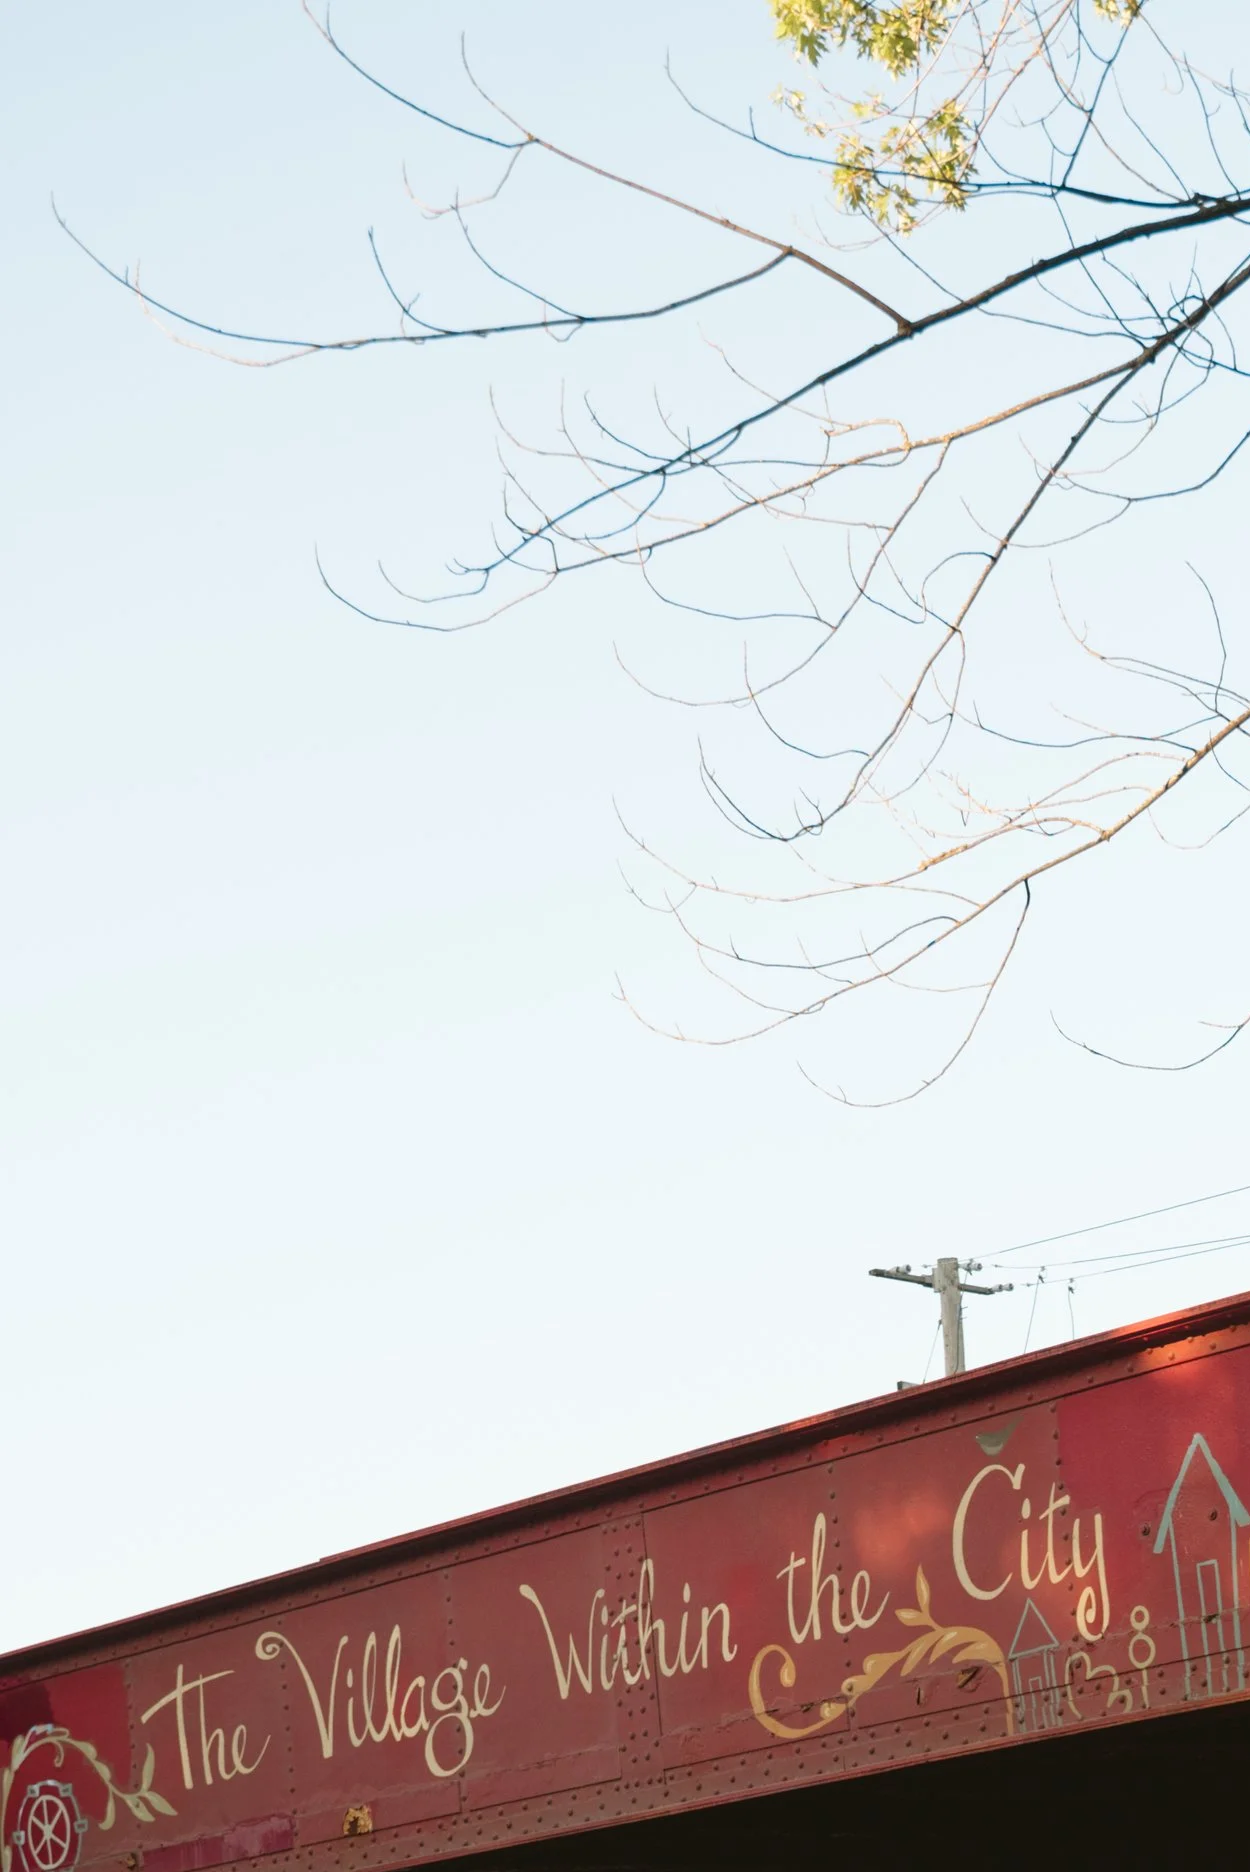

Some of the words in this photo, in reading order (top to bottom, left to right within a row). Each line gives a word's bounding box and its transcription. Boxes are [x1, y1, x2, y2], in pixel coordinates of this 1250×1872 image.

[140, 1663, 271, 1790] The
[254, 1623, 506, 1778] Village
[518, 1558, 738, 1700] Within
[776, 1511, 891, 1645] the
[951, 1463, 1111, 1643] City
